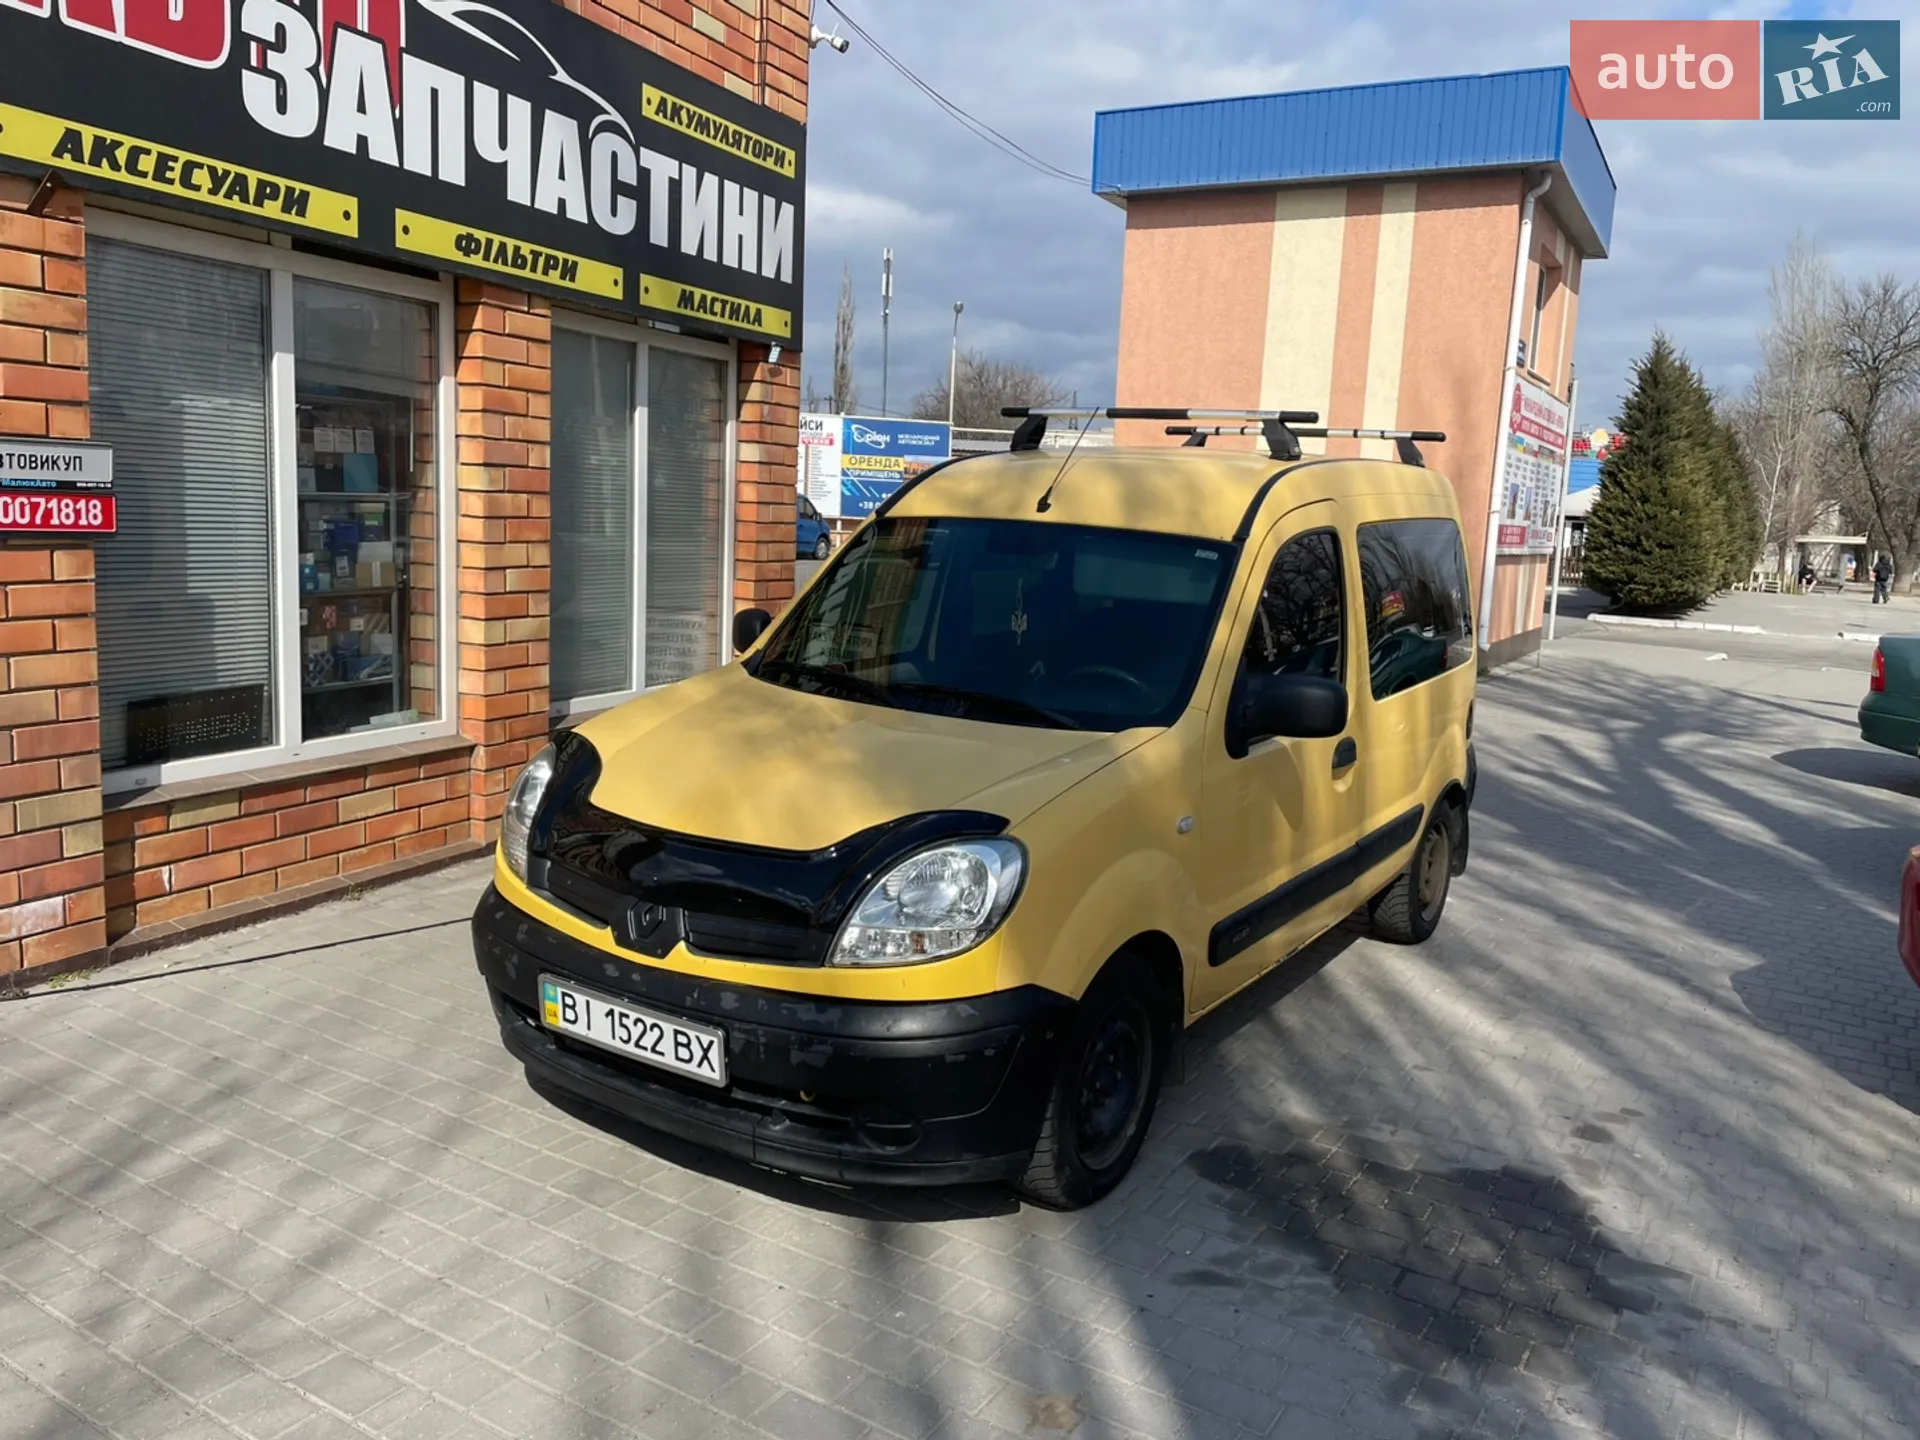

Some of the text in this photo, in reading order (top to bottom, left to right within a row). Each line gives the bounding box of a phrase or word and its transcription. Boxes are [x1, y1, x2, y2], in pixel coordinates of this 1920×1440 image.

[241, 0, 794, 284] ЗАПЧАСТИНИ
[654, 96, 787, 169] АКУМУЛЯТОРИ
[51, 126, 311, 219] АКСЕСУАРИ
[454, 232, 579, 284] ФІЛЬТРИ
[676, 288, 763, 328] МАСТИЛА
[849, 456, 901, 468] ОРЕНДА
[561, 991, 716, 1073] BI 1522 BX
